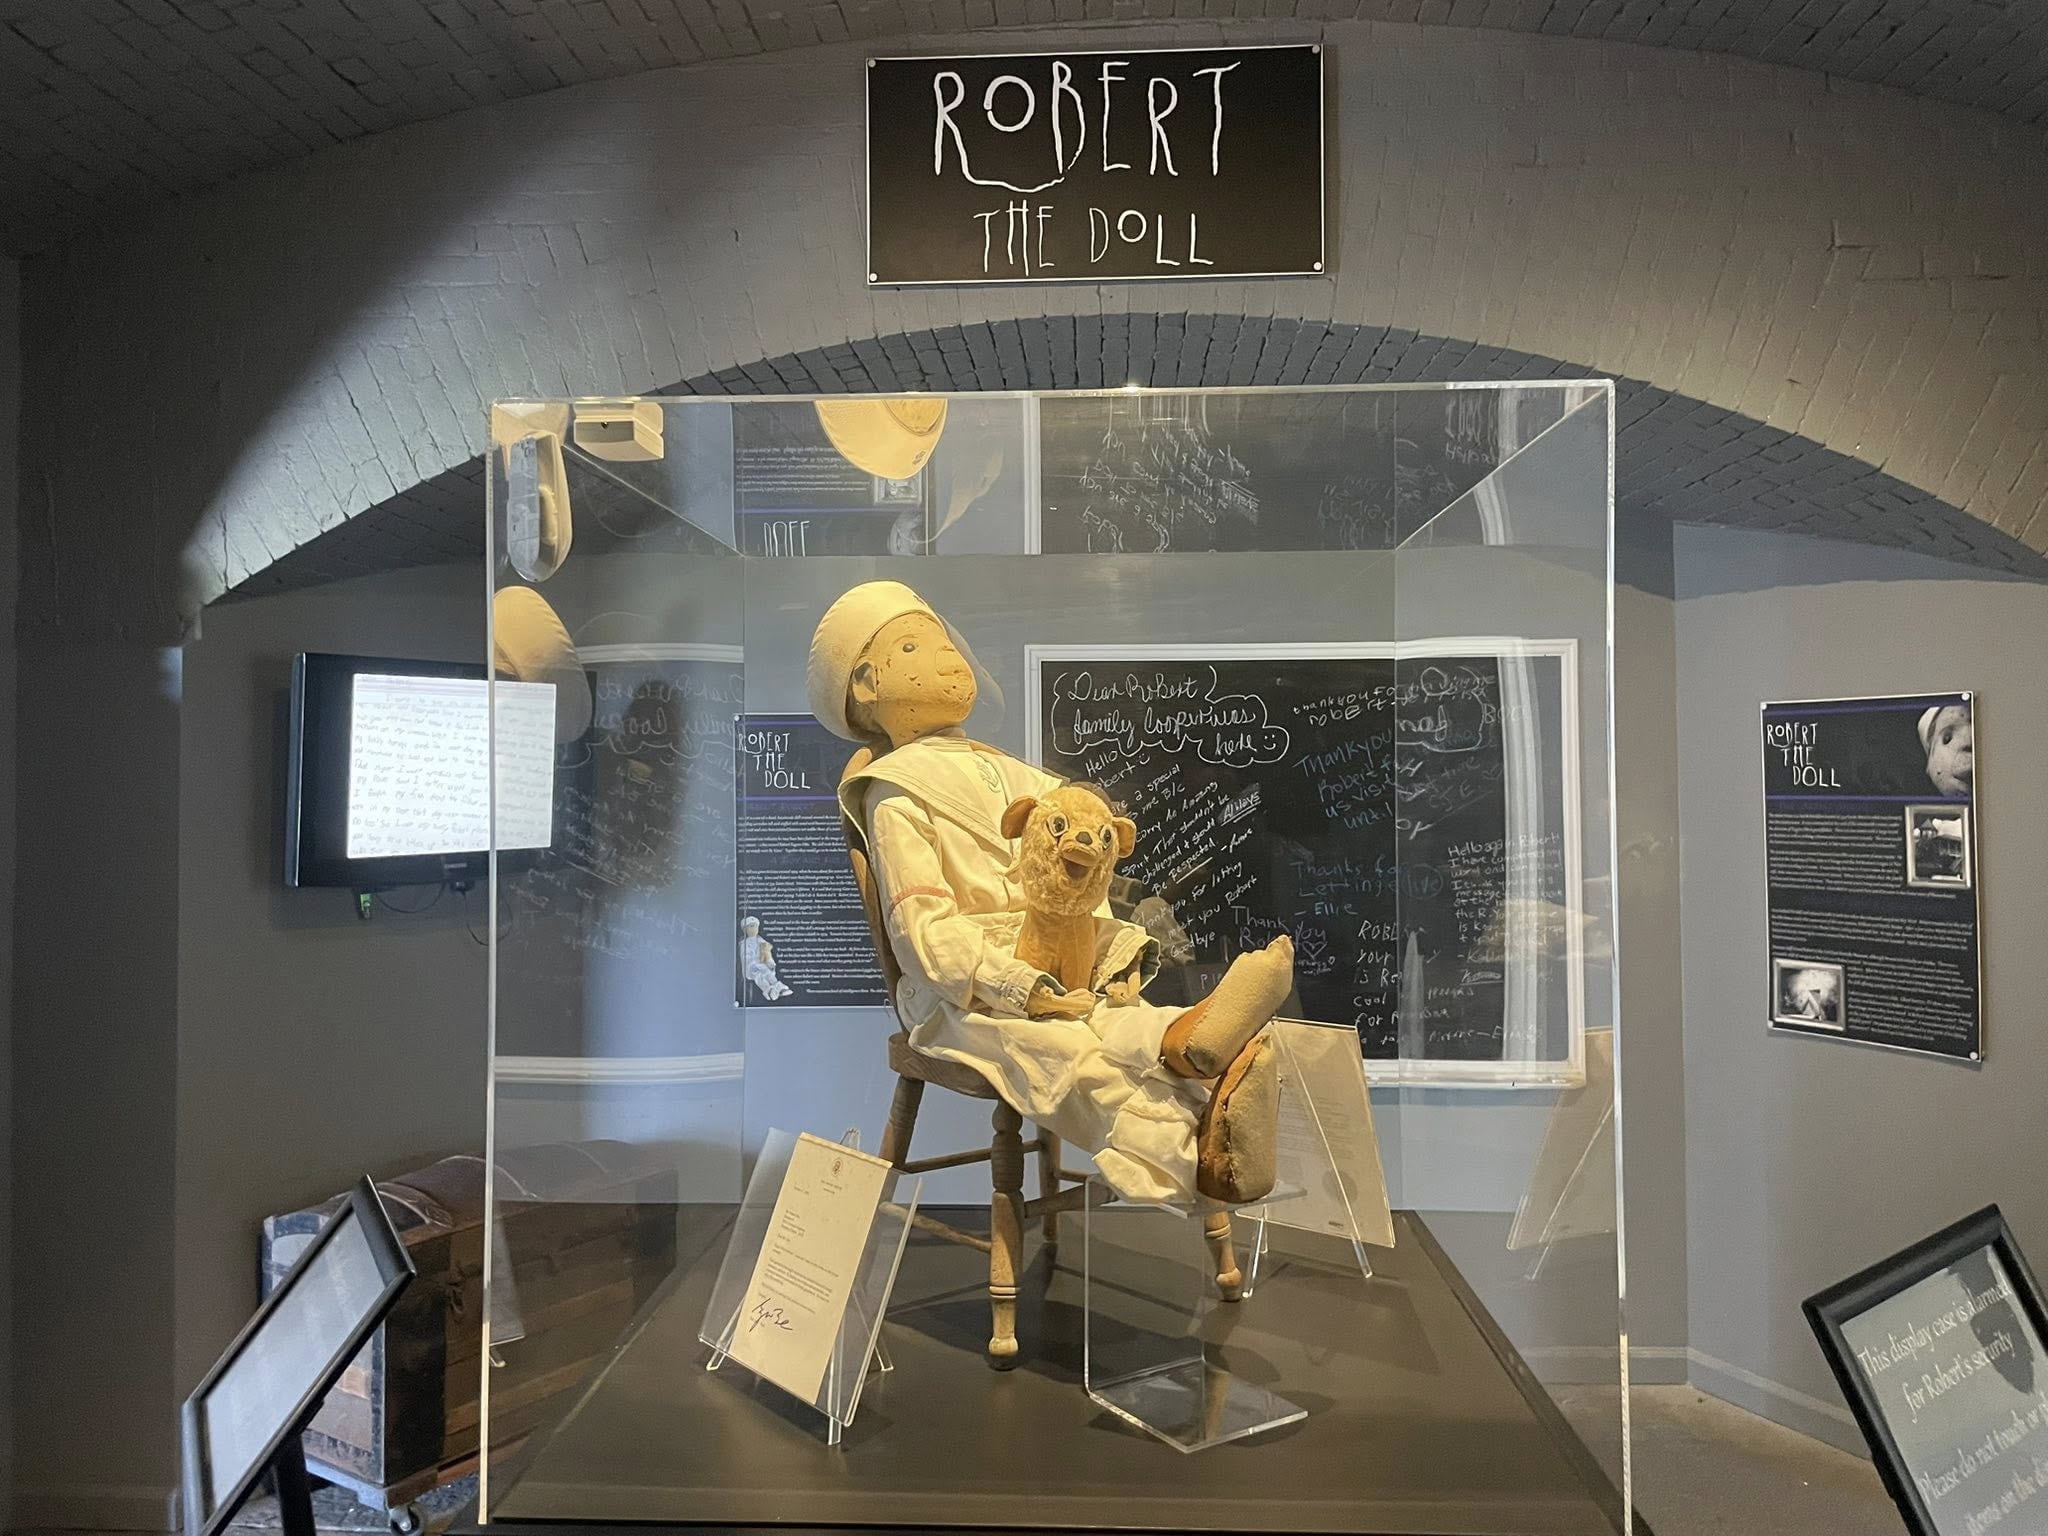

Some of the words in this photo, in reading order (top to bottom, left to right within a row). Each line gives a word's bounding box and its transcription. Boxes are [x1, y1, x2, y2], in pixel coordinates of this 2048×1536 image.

[933, 60, 1241, 193] ROBERT
[973, 199, 1055, 277] THE
[1089, 207, 1214, 266] DOLL
[738, 731, 791, 755] ROBERT
[1766, 722, 1818, 748] ROBERT
[753, 751, 786, 772] THE
[1085, 750, 1119, 778] Hello
[1780, 744, 1814, 767] THE
[765, 770, 811, 790] DOLL
[1095, 761, 1136, 789] obert
[1147, 763, 1181, 793] special
[1792, 765, 1841, 788] DOLL
[1197, 903, 1221, 926] you
[1230, 905, 1289, 933] Thank
[1857, 1346, 1892, 1377] This
[1887, 1321, 1935, 1362] display
[1932, 1311, 1958, 1336] case
[1951, 1301, 1969, 1322] is
[1966, 1274, 2012, 1318] alarmed
[1902, 1381, 1926, 1424] for
[1921, 1353, 1974, 1399] Robert's
[1970, 1330, 2016, 1370] security
[1917, 1470, 1961, 1506] Please
[1956, 1447, 1977, 1479] do
